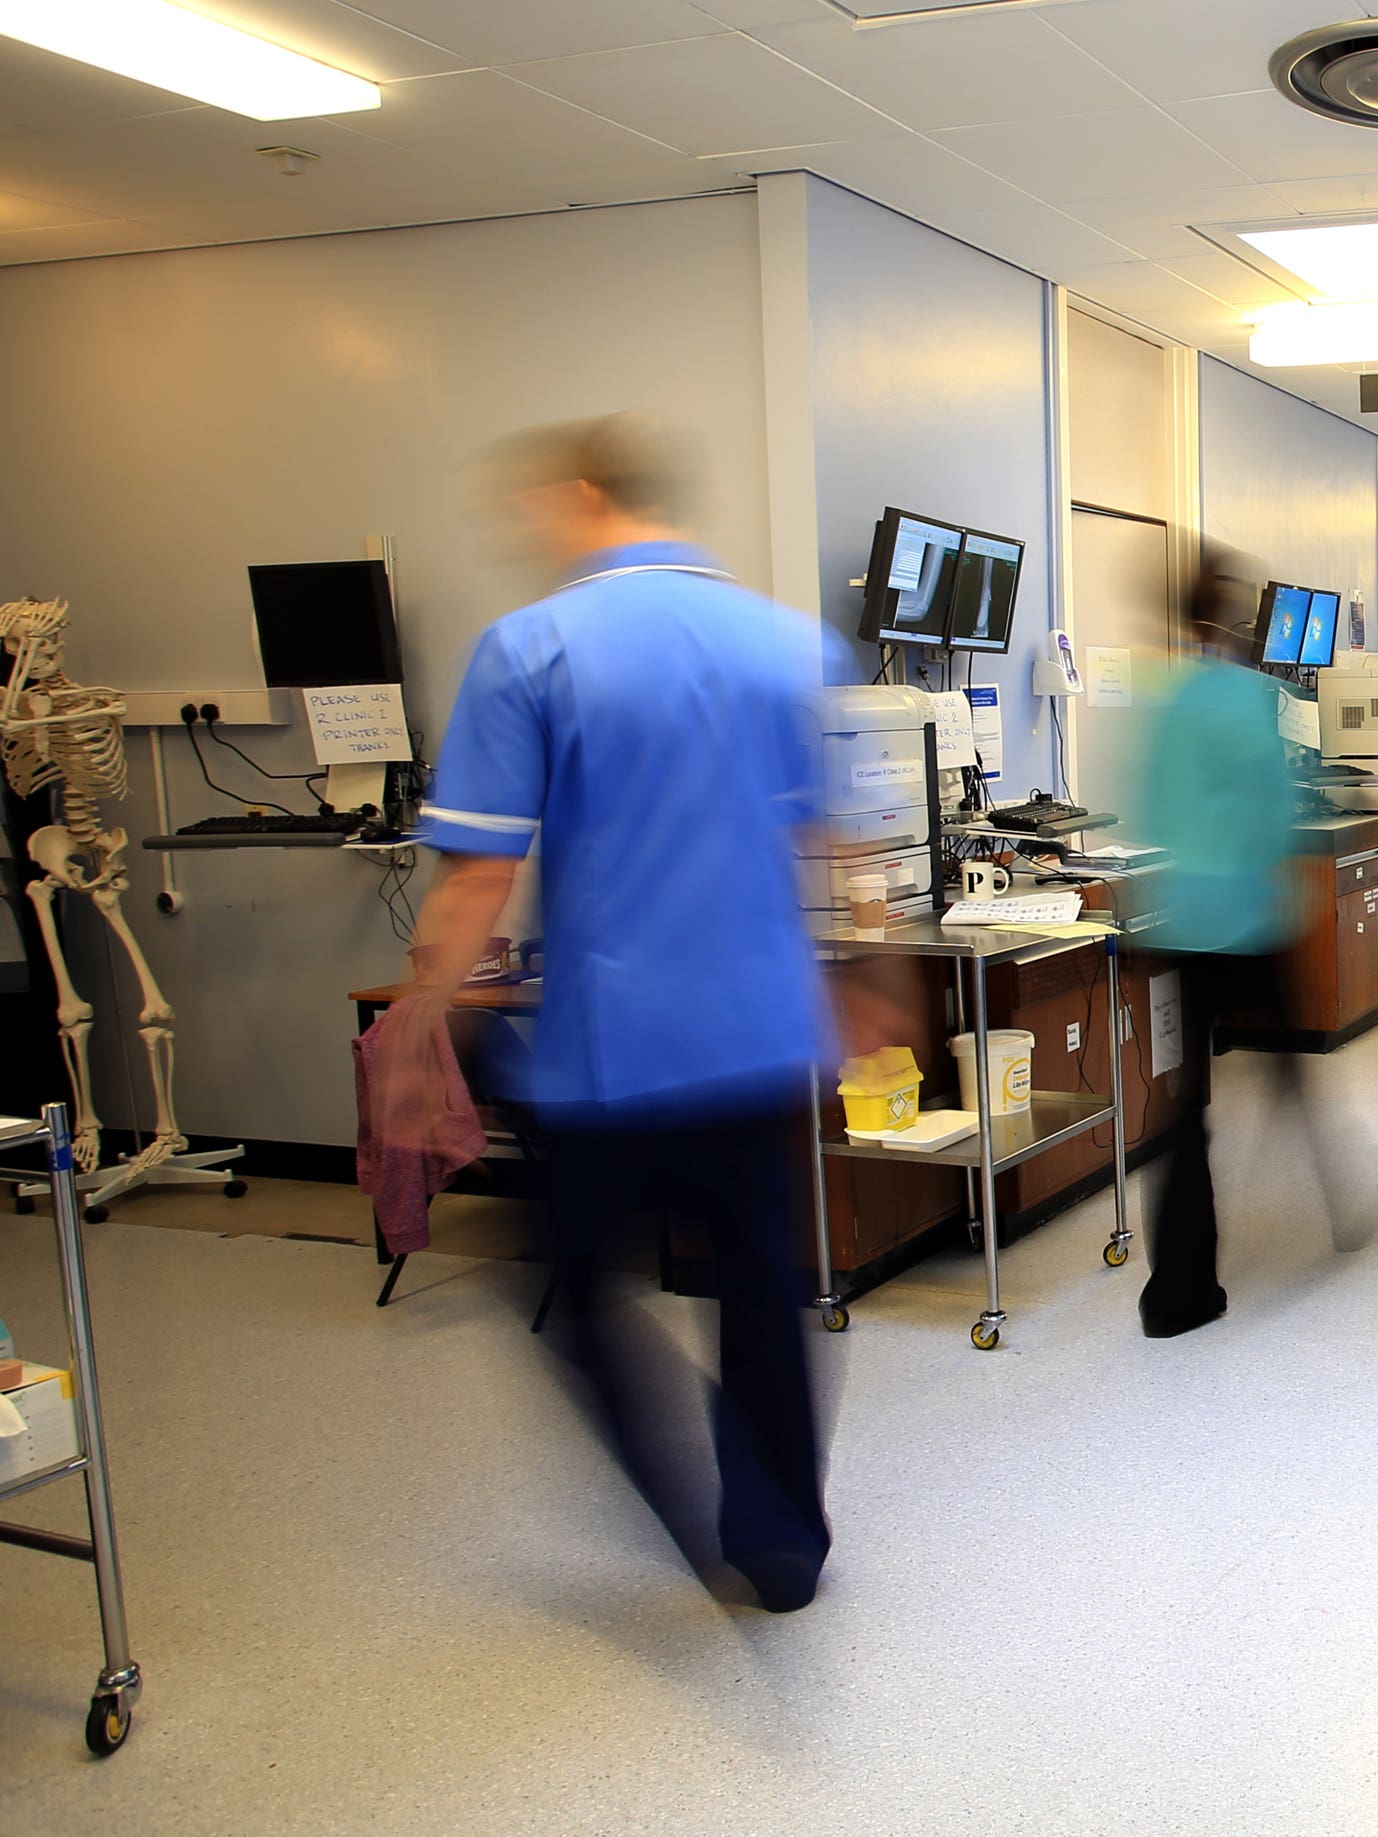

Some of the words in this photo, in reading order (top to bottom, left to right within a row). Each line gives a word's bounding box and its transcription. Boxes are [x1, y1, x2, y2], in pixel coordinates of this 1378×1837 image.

[310, 694, 361, 707] PLEASE
[370, 693, 391, 703] USE
[944, 698, 957, 707] USE
[335, 711, 374, 722] CLINIC
[951, 711, 959, 723] 2
[323, 727, 381, 740] PRINTER
[347, 742, 390, 752] THANKS
[966, 871, 984, 893] P
